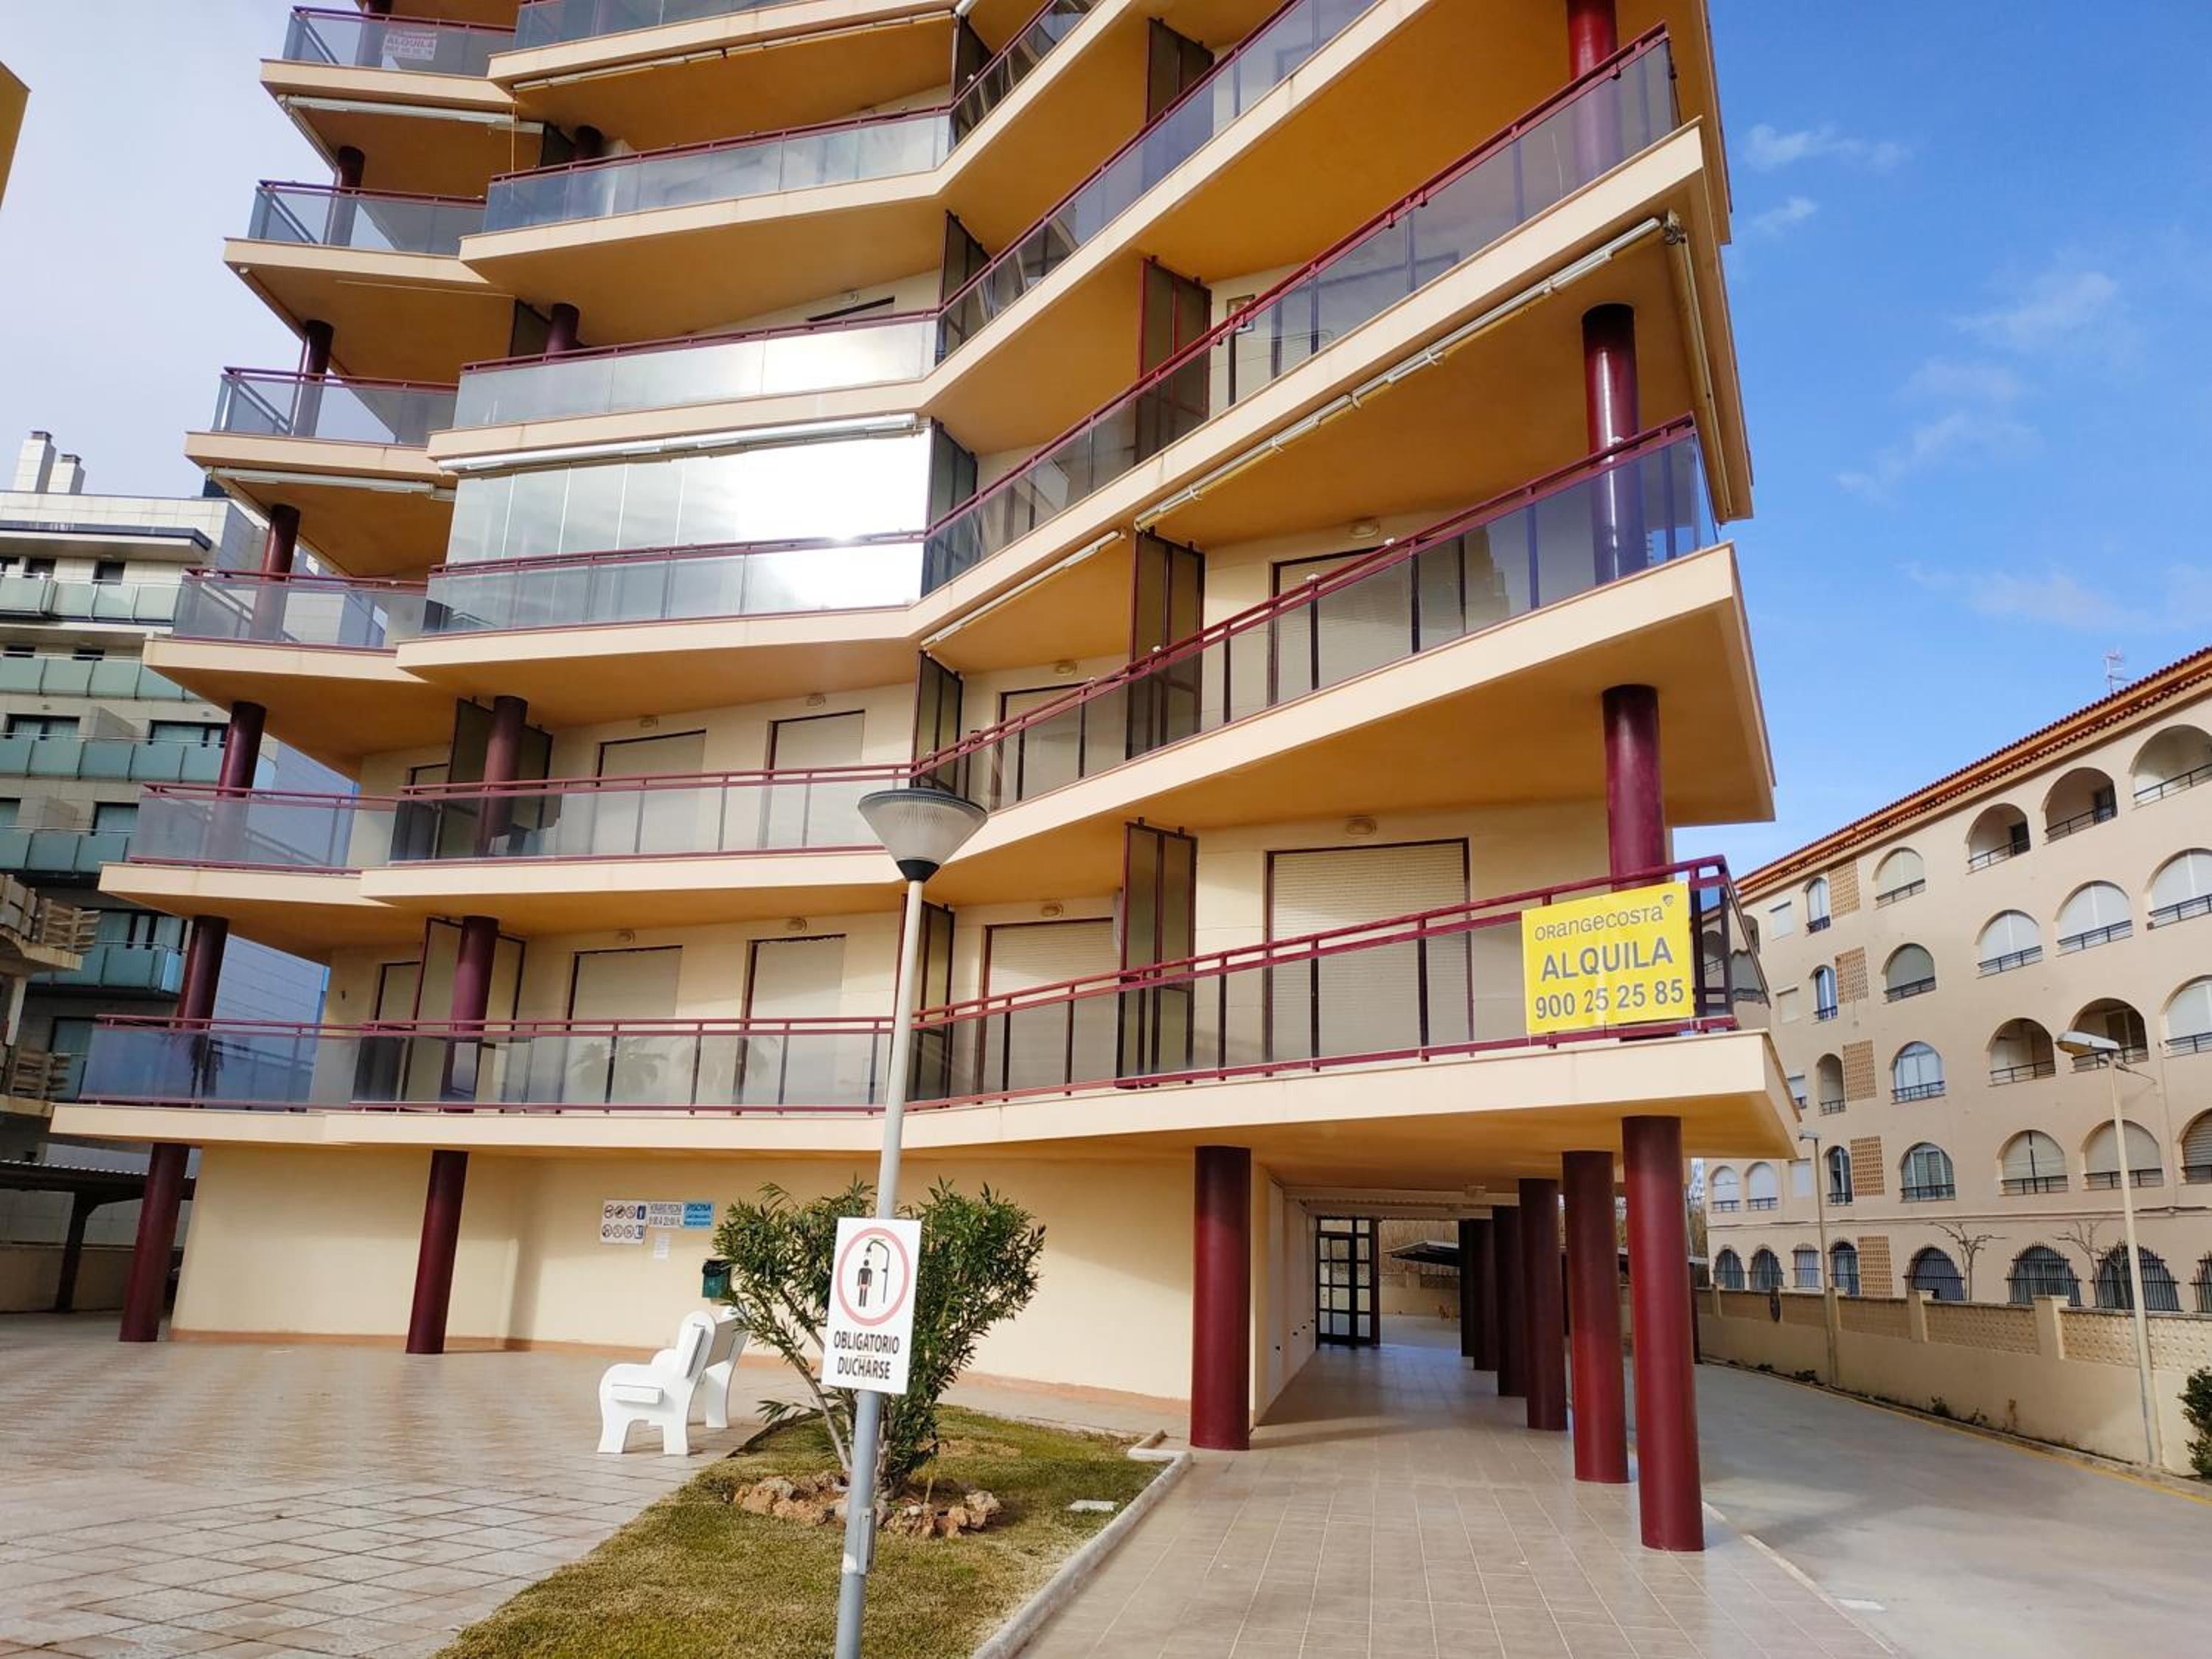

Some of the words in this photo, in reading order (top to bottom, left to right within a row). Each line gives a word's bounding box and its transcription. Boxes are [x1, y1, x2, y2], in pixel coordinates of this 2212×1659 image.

[387, 36, 434, 47] ALQUILA
[1541, 936, 1673, 982] ALQUILA
[1536, 992, 1576, 1020] 900
[1585, 987, 1610, 1013] 25
[1616, 983, 1646, 1009] 25
[1654, 978, 1684, 1005] 85
[834, 1330, 900, 1354] OBLIGATORIO
[837, 1356, 891, 1380] DUCHARSE
